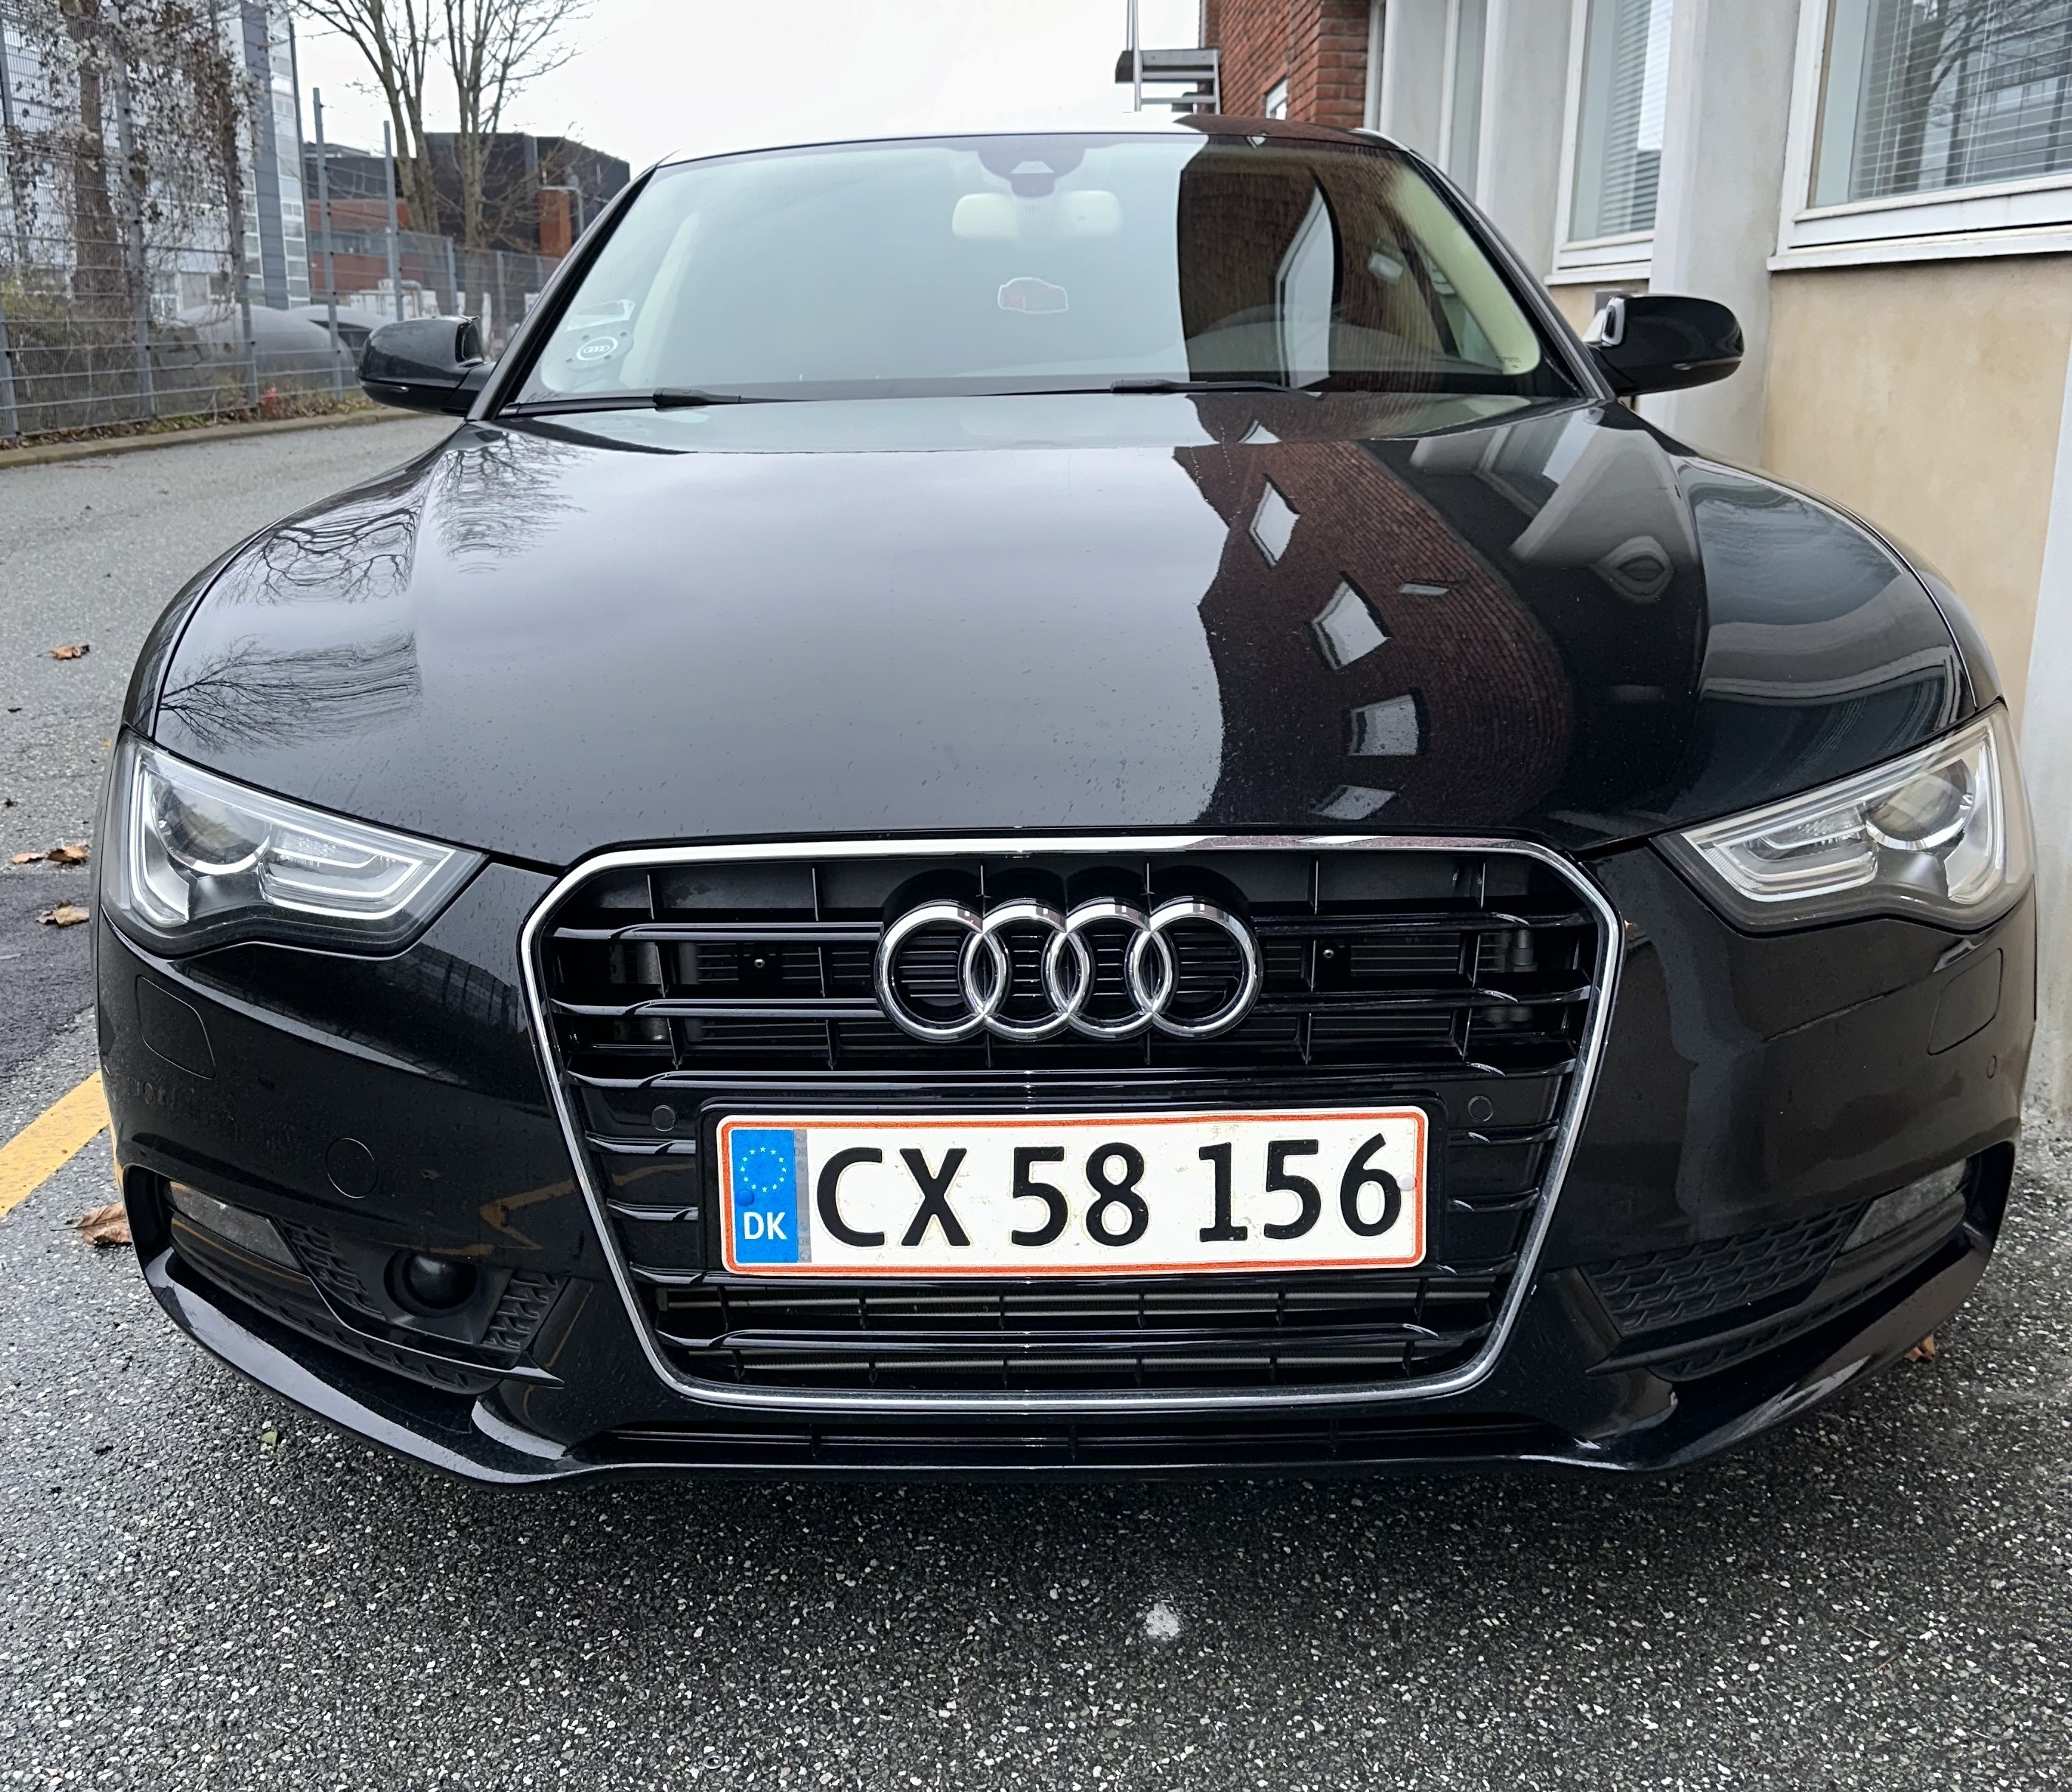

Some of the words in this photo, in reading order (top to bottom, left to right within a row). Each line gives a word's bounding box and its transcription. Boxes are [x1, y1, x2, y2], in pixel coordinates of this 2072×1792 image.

[744, 1211, 787, 1240] DK
[817, 1147, 971, 1247] CX
[1011, 1142, 1149, 1247] 58
[1198, 1133, 1402, 1243] 156
